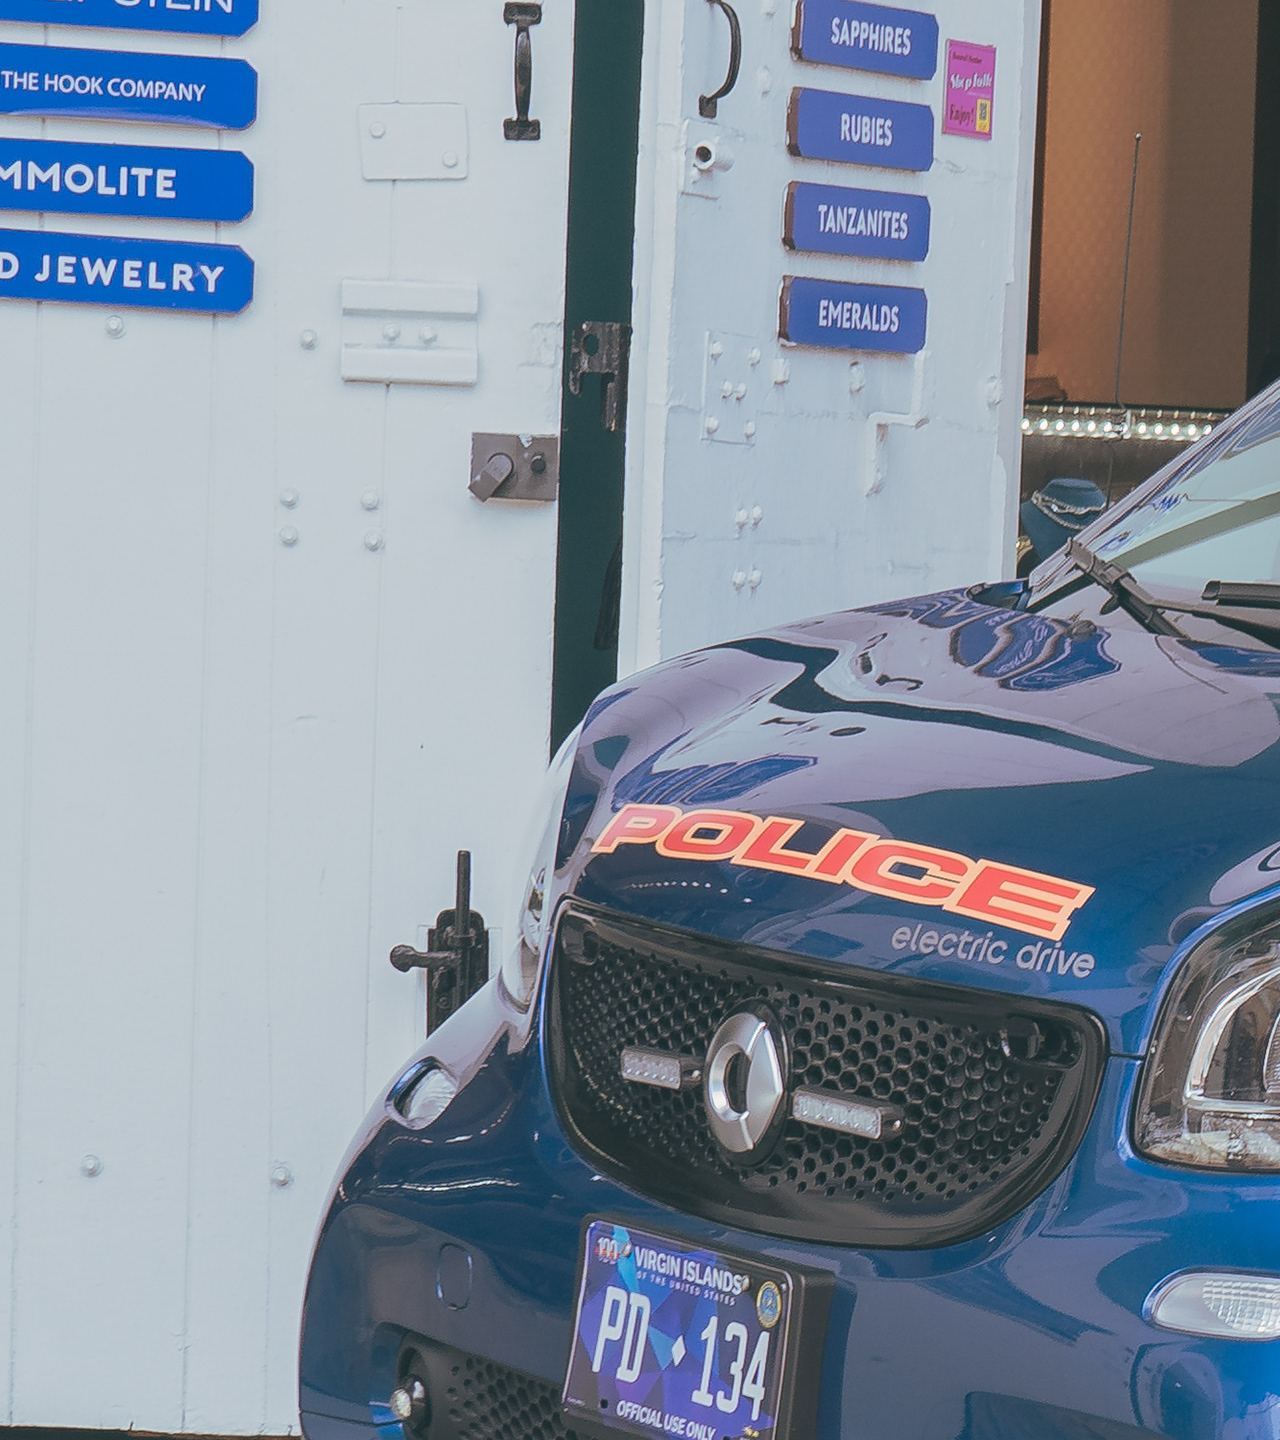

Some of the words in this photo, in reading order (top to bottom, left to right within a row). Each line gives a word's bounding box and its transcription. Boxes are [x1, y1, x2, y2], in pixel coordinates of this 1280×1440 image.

[831, 16, 911, 56] SAPPHIRES
[1, 70, 39, 92] THE
[43, 73, 104, 96] HOOK
[107, 77, 206, 102] COMPANY
[840, 112, 893, 147] RUBIES
[818, 204, 909, 241] TANZANITES
[34, 253, 225, 293] JEWELRY
[818, 299, 899, 334] EMERALDS
[590, 803, 1097, 942] POLICE
[891, 922, 1006, 966] electric
[1016, 939, 1096, 980] drive
[635, 1246, 681, 1278] VIRGIN
[682, 1258, 743, 1296] ISLANDS
[669, 1280, 701, 1297] UNITED
[703, 1288, 737, 1307] STATES
[591, 1285, 652, 1383] PD
[691, 1315, 771, 1421] 134
[616, 1399, 663, 1429] OFFICIAL
[663, 1413, 687, 1436] USE
